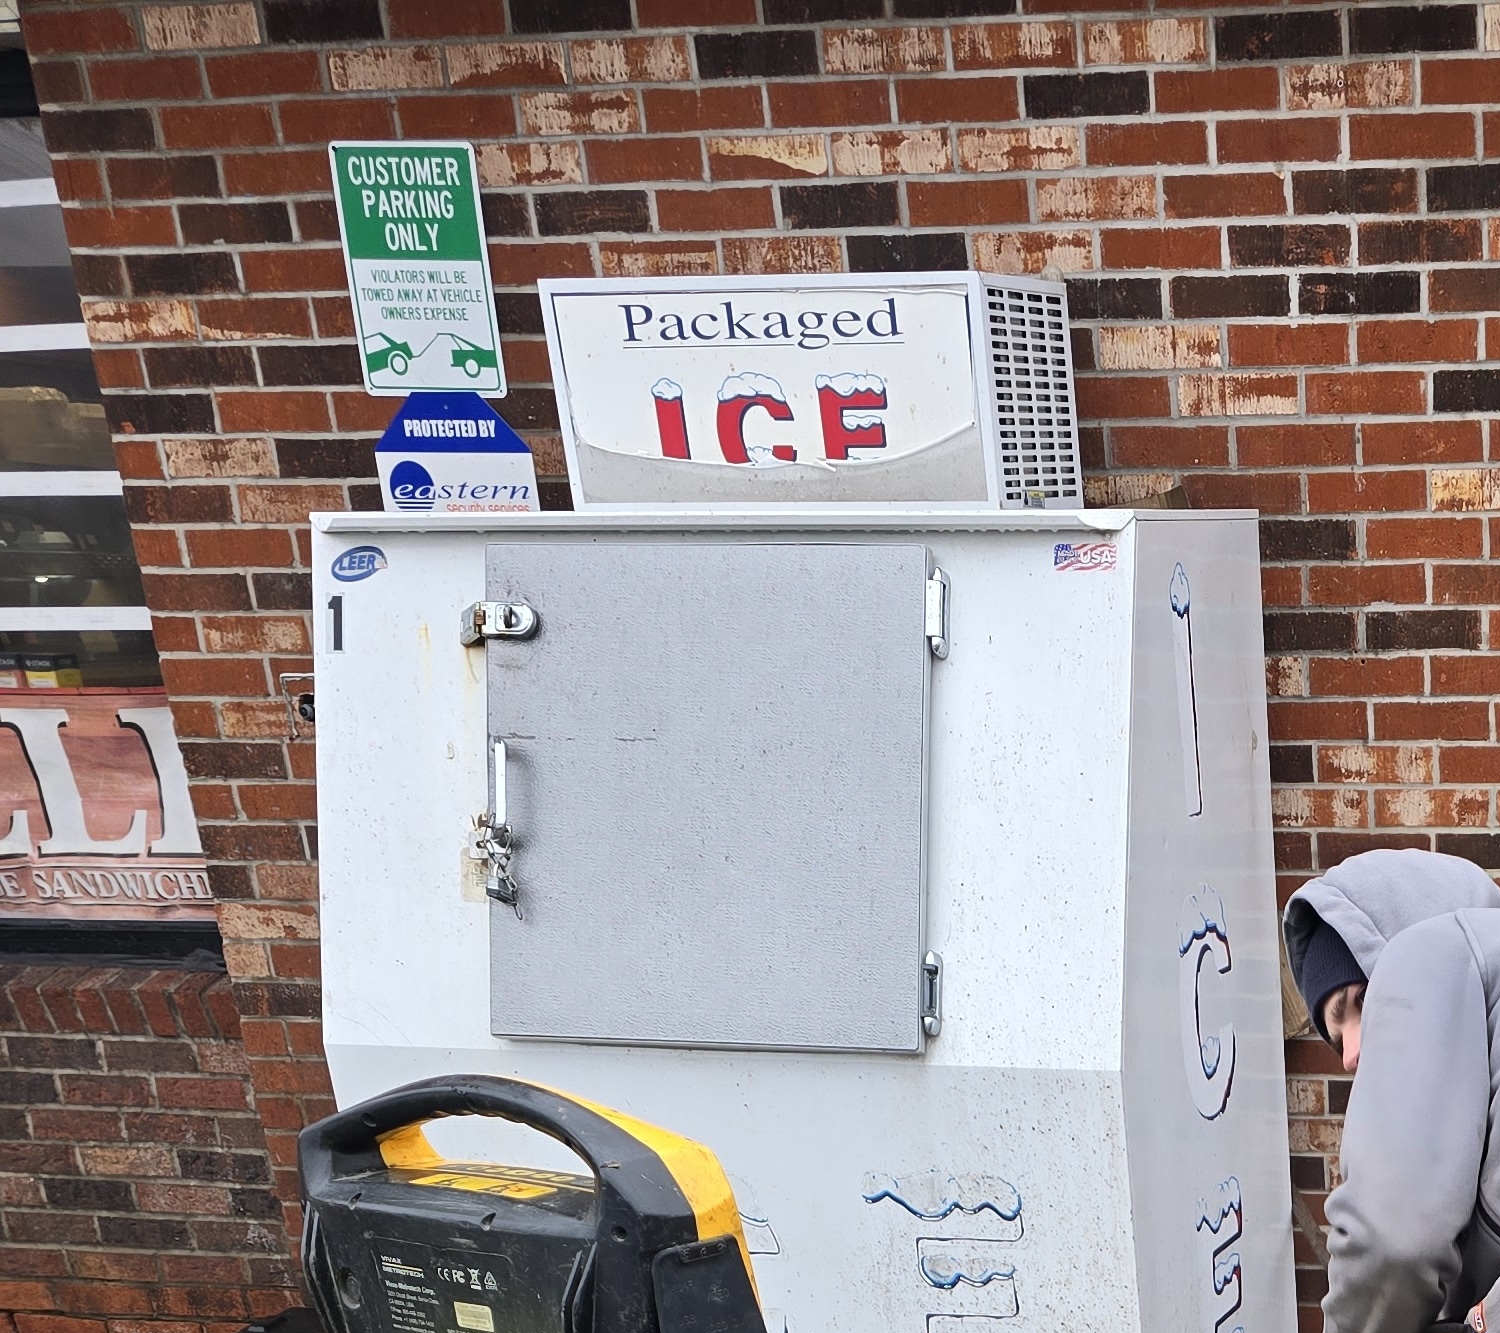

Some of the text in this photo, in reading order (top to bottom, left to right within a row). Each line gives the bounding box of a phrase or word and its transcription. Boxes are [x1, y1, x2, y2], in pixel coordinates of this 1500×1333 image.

[347, 156, 461, 186] CUSTOMER
[361, 190, 455, 219] PARKING
[384, 222, 439, 251] ONLY
[371, 269, 468, 284] VIOLATORS WILL BE
[361, 287, 483, 303] TOWED AWAY AT VEHICLE
[381, 306, 469, 321] OWNERS EXPENSE
[617, 298, 903, 350] Packaged
[403, 419, 496, 438] PROTECTED BY
[394, 481, 530, 500] eastern
[338, 554, 376, 571] LEER
[1080, 549, 1113, 564] USA
[327, 595, 344, 651] 1
[0, 706, 204, 854] LI
[32, 868, 214, 899] SANDWICH
